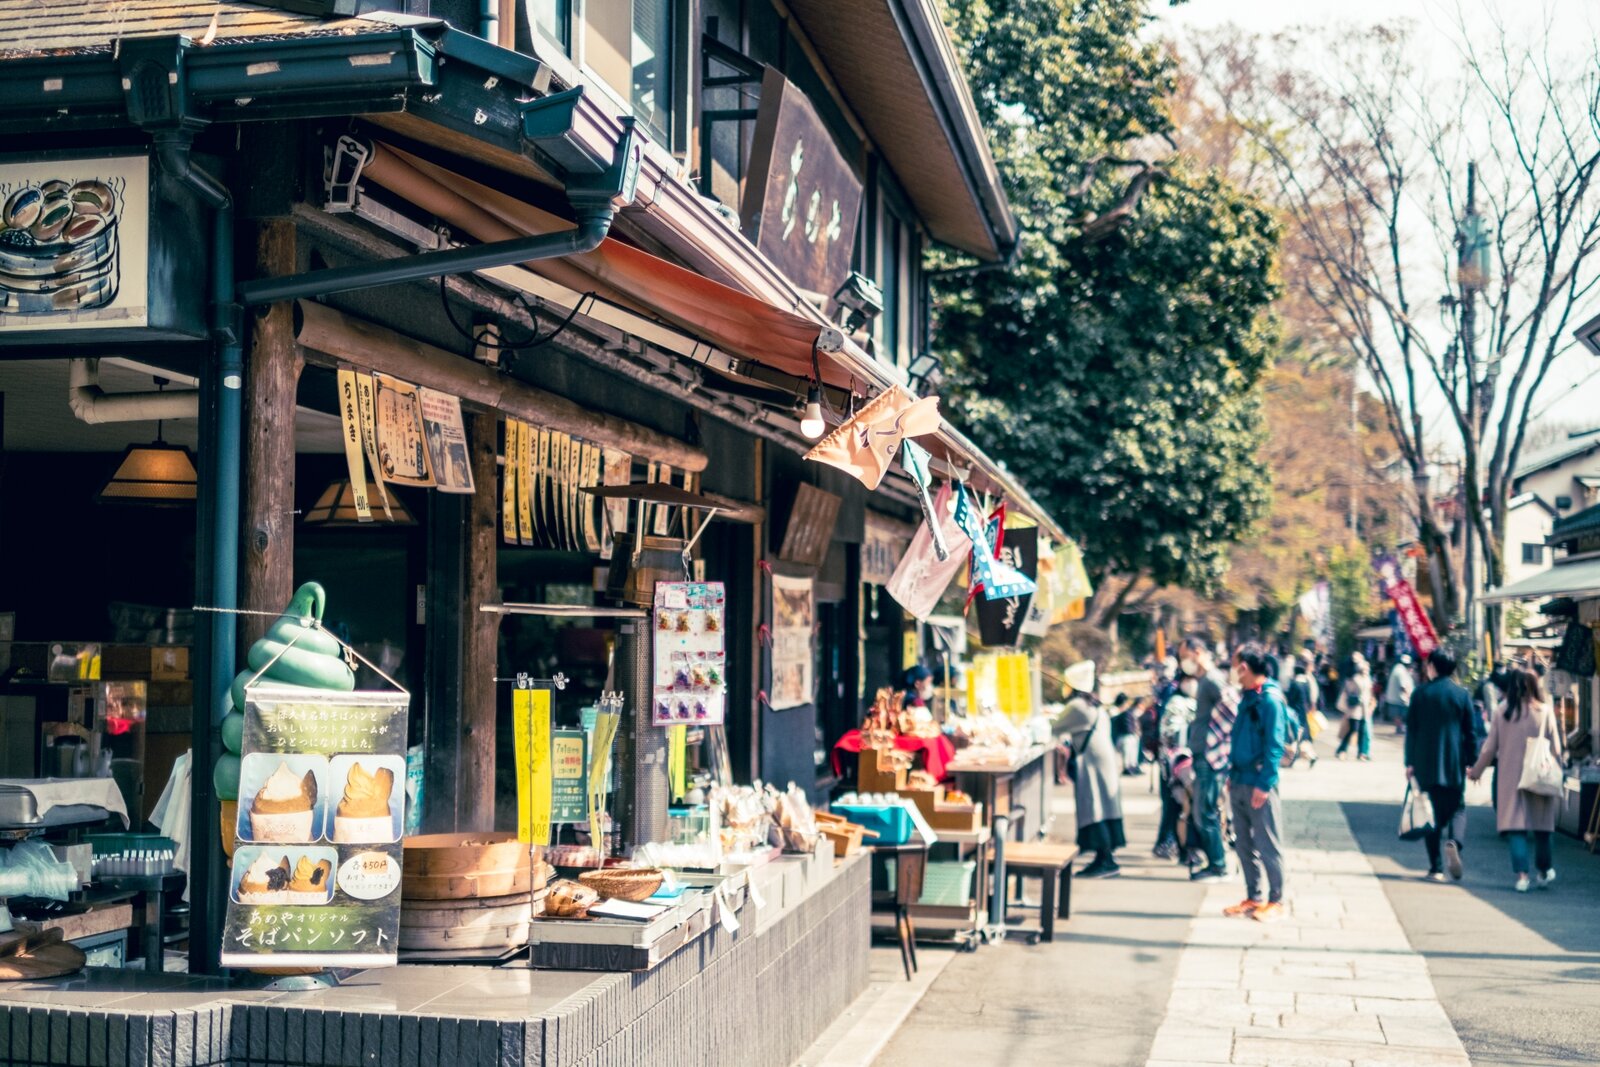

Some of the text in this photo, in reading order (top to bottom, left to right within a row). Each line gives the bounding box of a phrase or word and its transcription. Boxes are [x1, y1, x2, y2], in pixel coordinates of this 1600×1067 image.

[266, 723, 389, 735] おいしいソフトクリームが
[276, 737, 373, 749] ひとつになりました。
[235, 926, 389, 947] そばパンソフト
